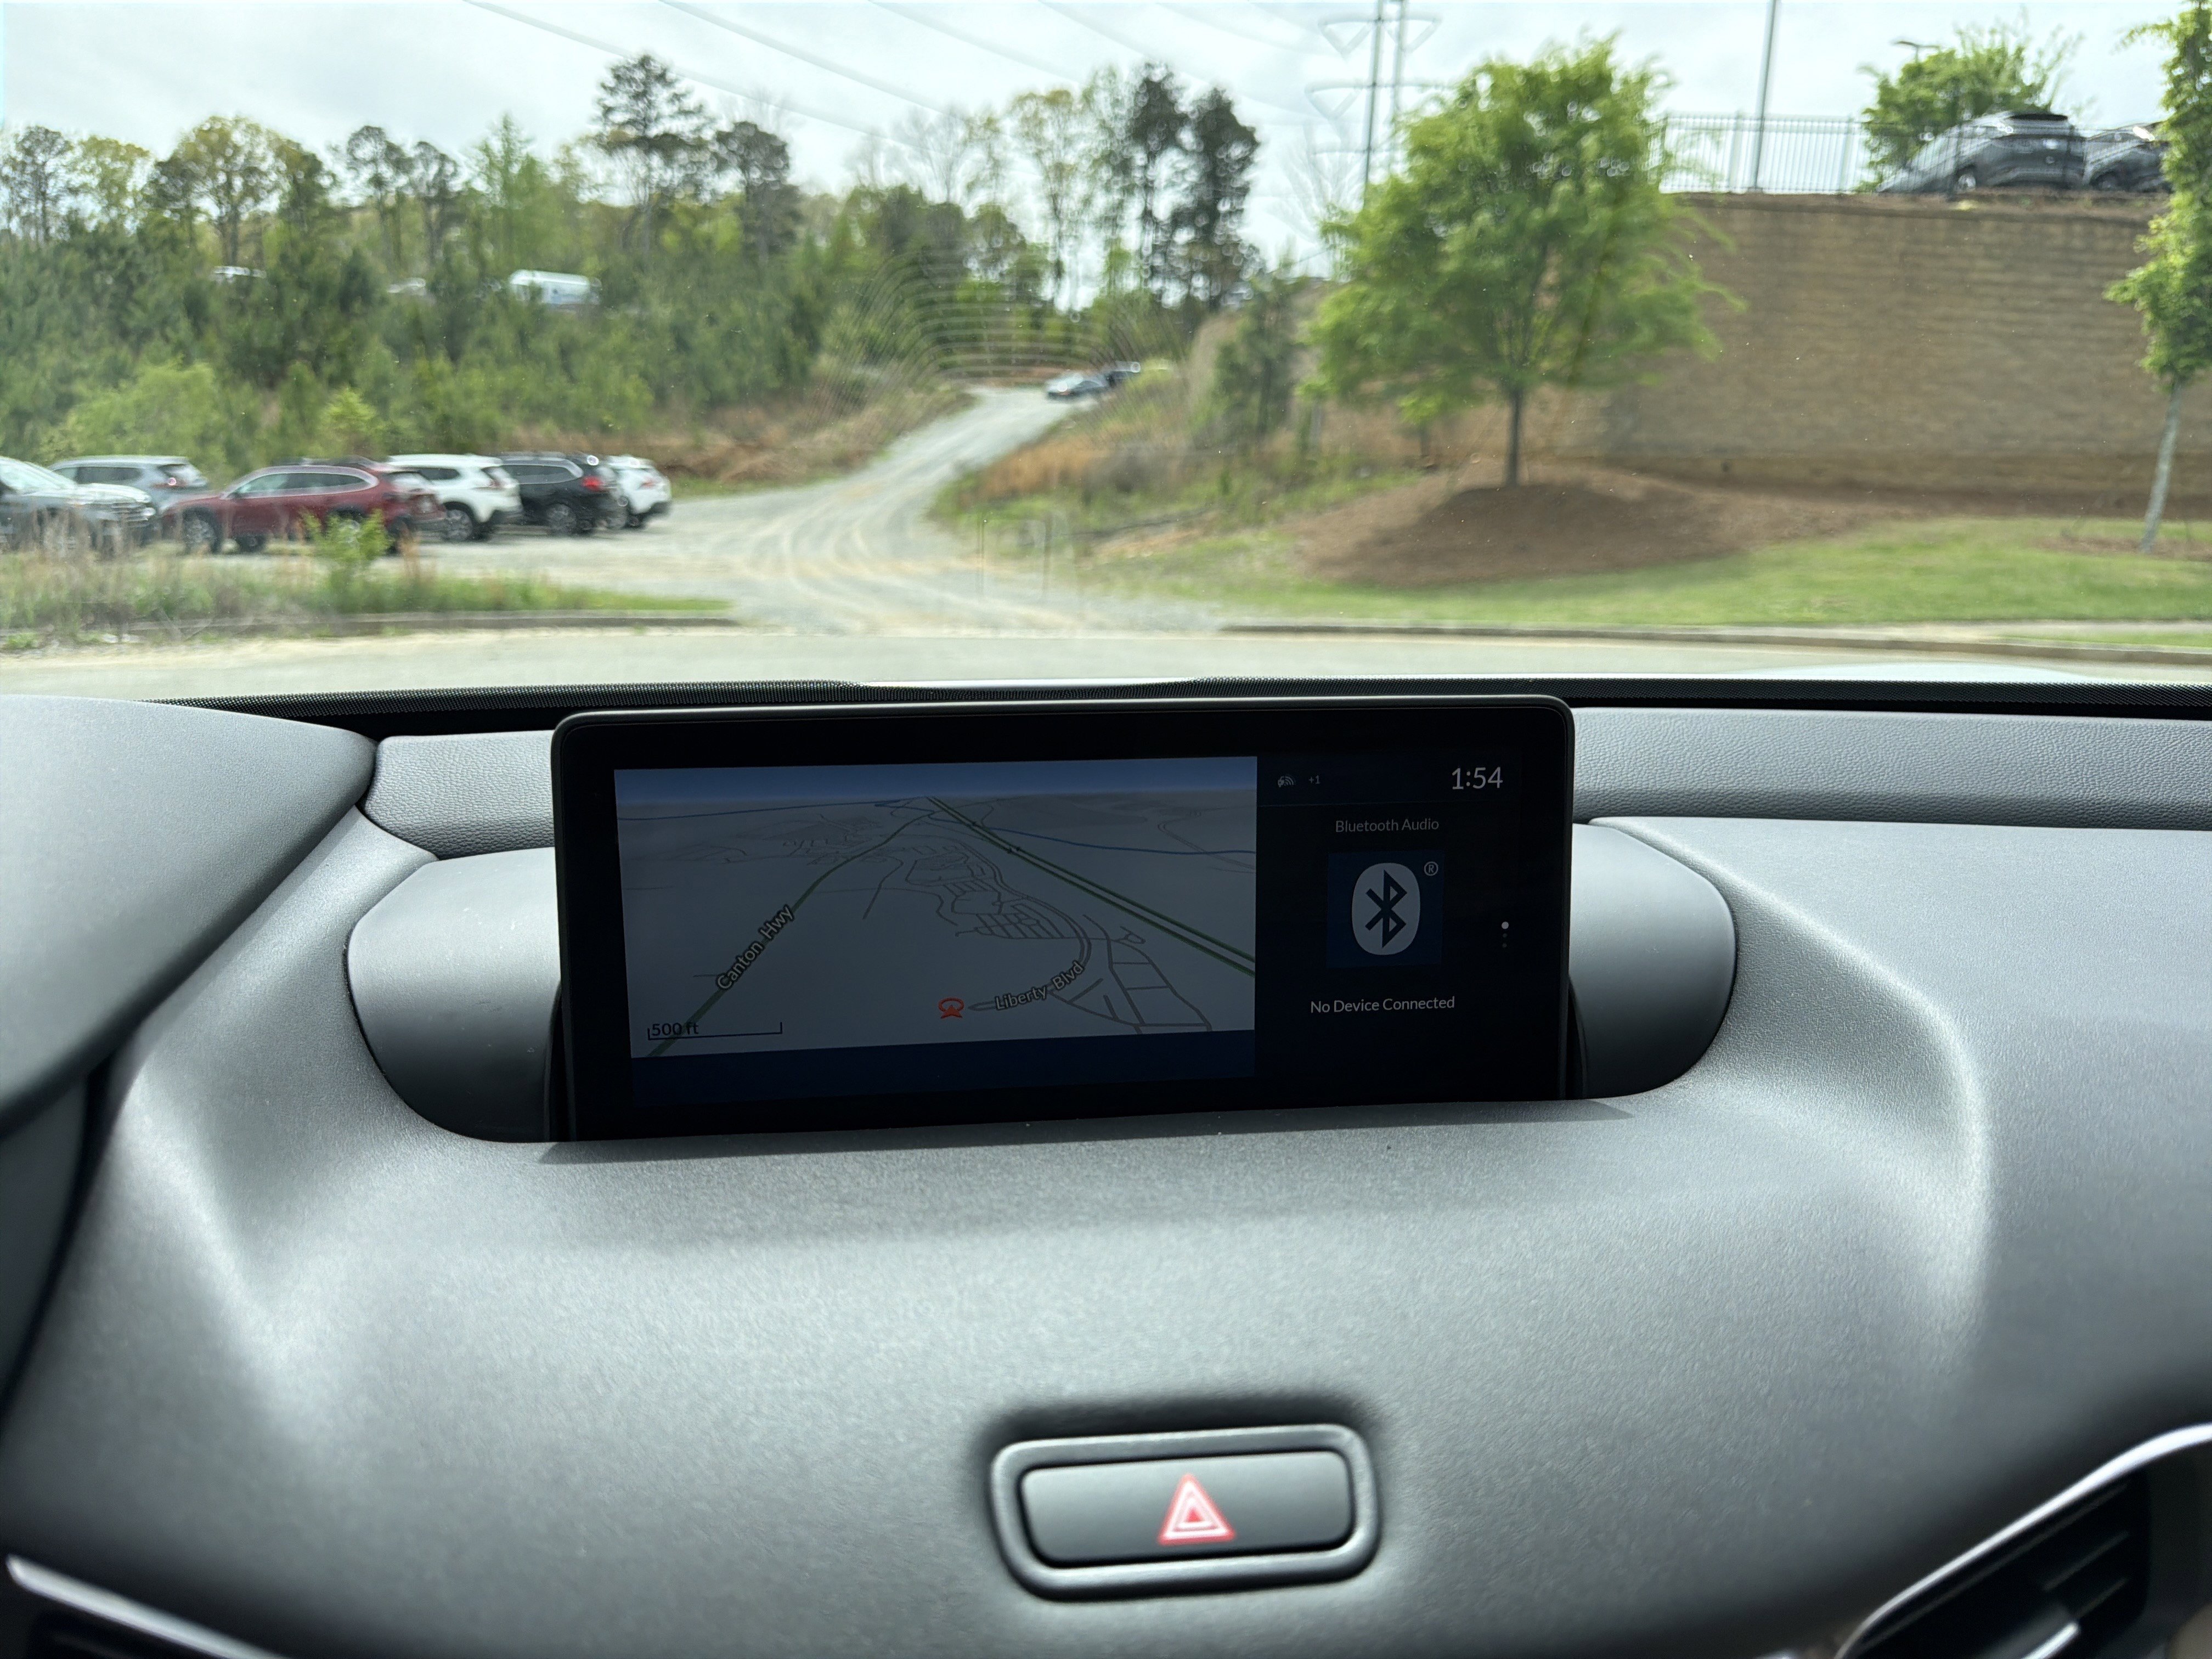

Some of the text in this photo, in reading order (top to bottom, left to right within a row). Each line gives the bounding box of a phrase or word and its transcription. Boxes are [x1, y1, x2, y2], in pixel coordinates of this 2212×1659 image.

[1452, 766, 1503, 790] 1:54
[1335, 818, 1440, 833] Bluetooth Audio
[716, 905, 795, 990] Canton Hwy
[995, 961, 1084, 1010] Liberty Blvd
[1311, 995, 1455, 1013] No Device Connected
[652, 1023, 699, 1036] 500 ft
